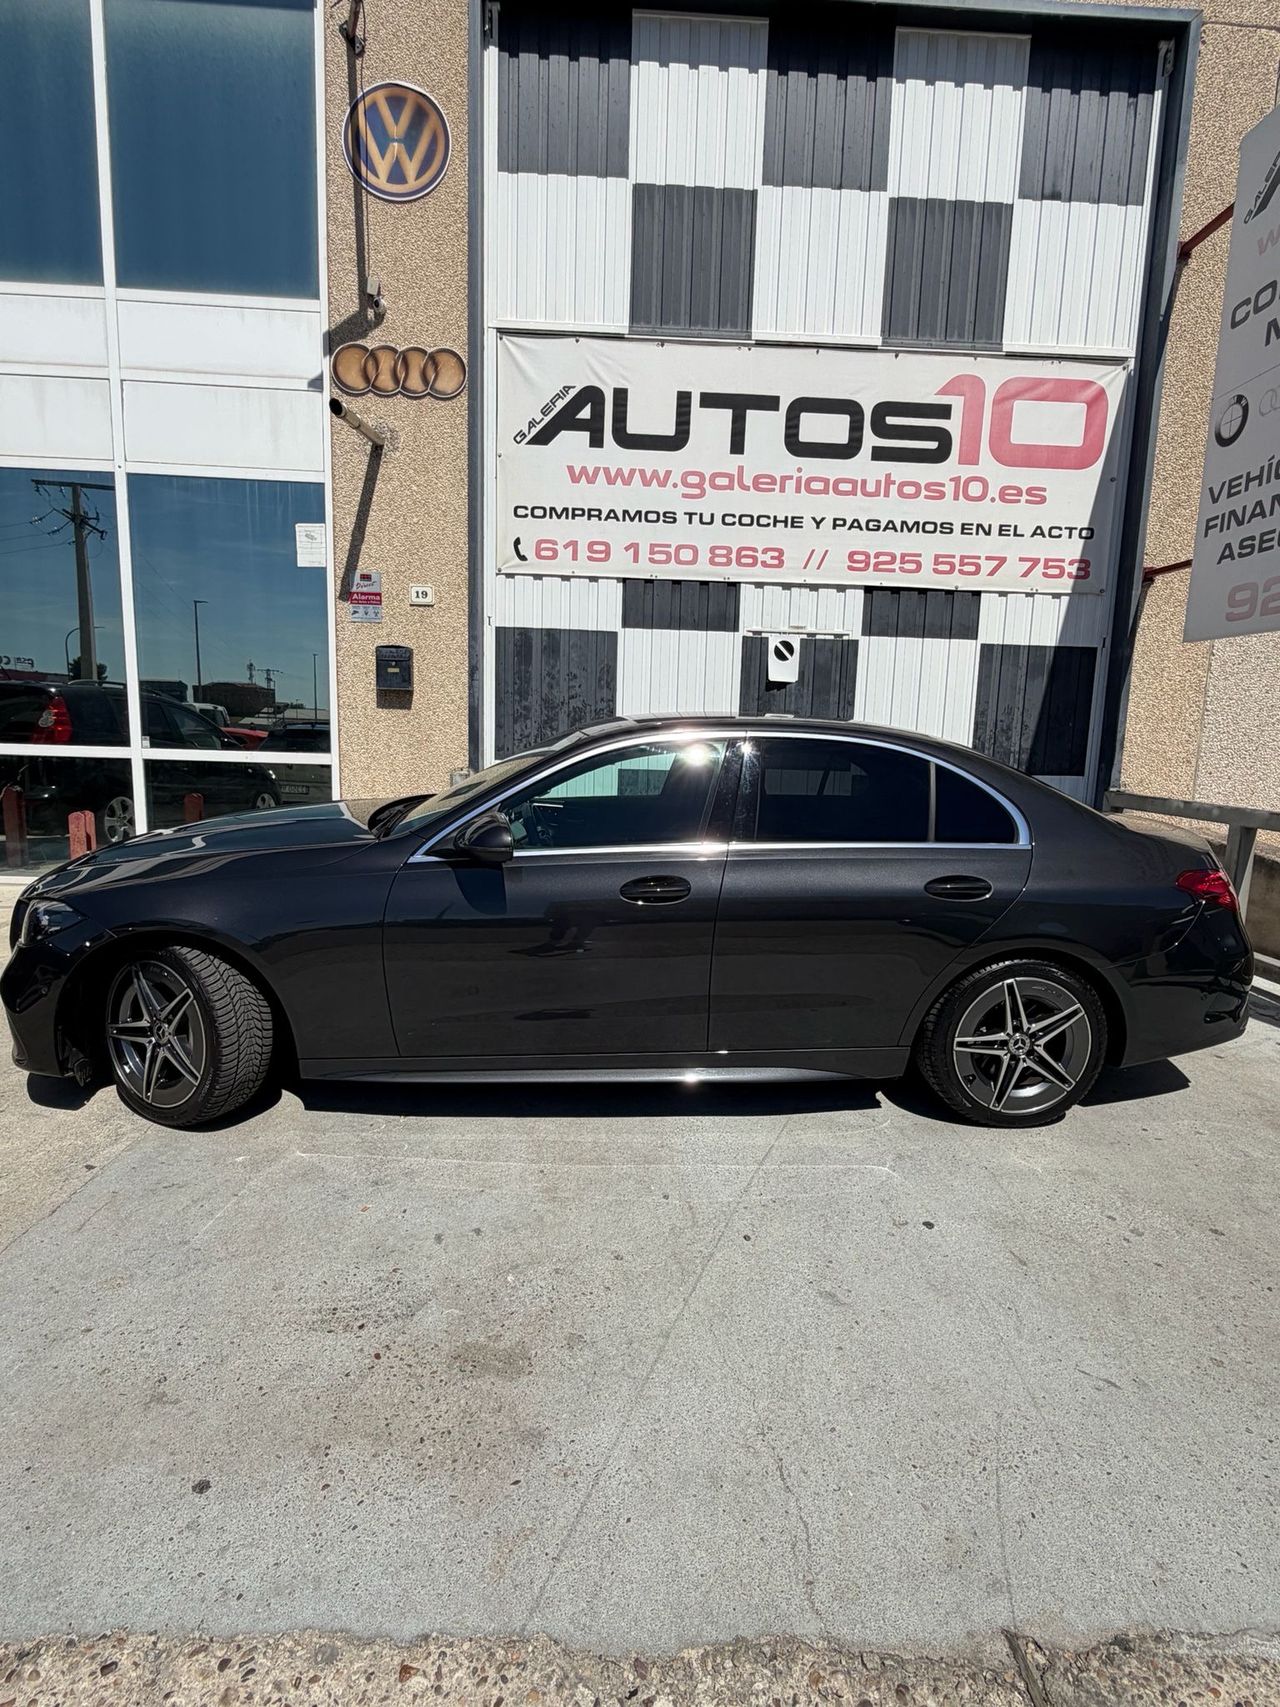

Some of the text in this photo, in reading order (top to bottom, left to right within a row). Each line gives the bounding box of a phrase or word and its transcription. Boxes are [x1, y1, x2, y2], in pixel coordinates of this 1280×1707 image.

[1230, 279, 1280, 330] CO
[513, 385, 577, 445] GALERIA
[524, 373, 1109, 470] AUTOS10
[566, 464, 1047, 506] www.galeriaautos10.es
[513, 505, 1095, 540] COMPRAMOS TU COCHE Y PAGAMOS EN EL ACTO
[534, 538, 611, 562] 619
[623, 542, 699, 566] 150
[708, 545, 785, 569] 863
[847, 550, 922, 574] 925
[932, 553, 1008, 577] 557
[1018, 556, 1091, 580] 753
[1216, 528, 1280, 566] ASE
[414, 590, 428, 599] 19
